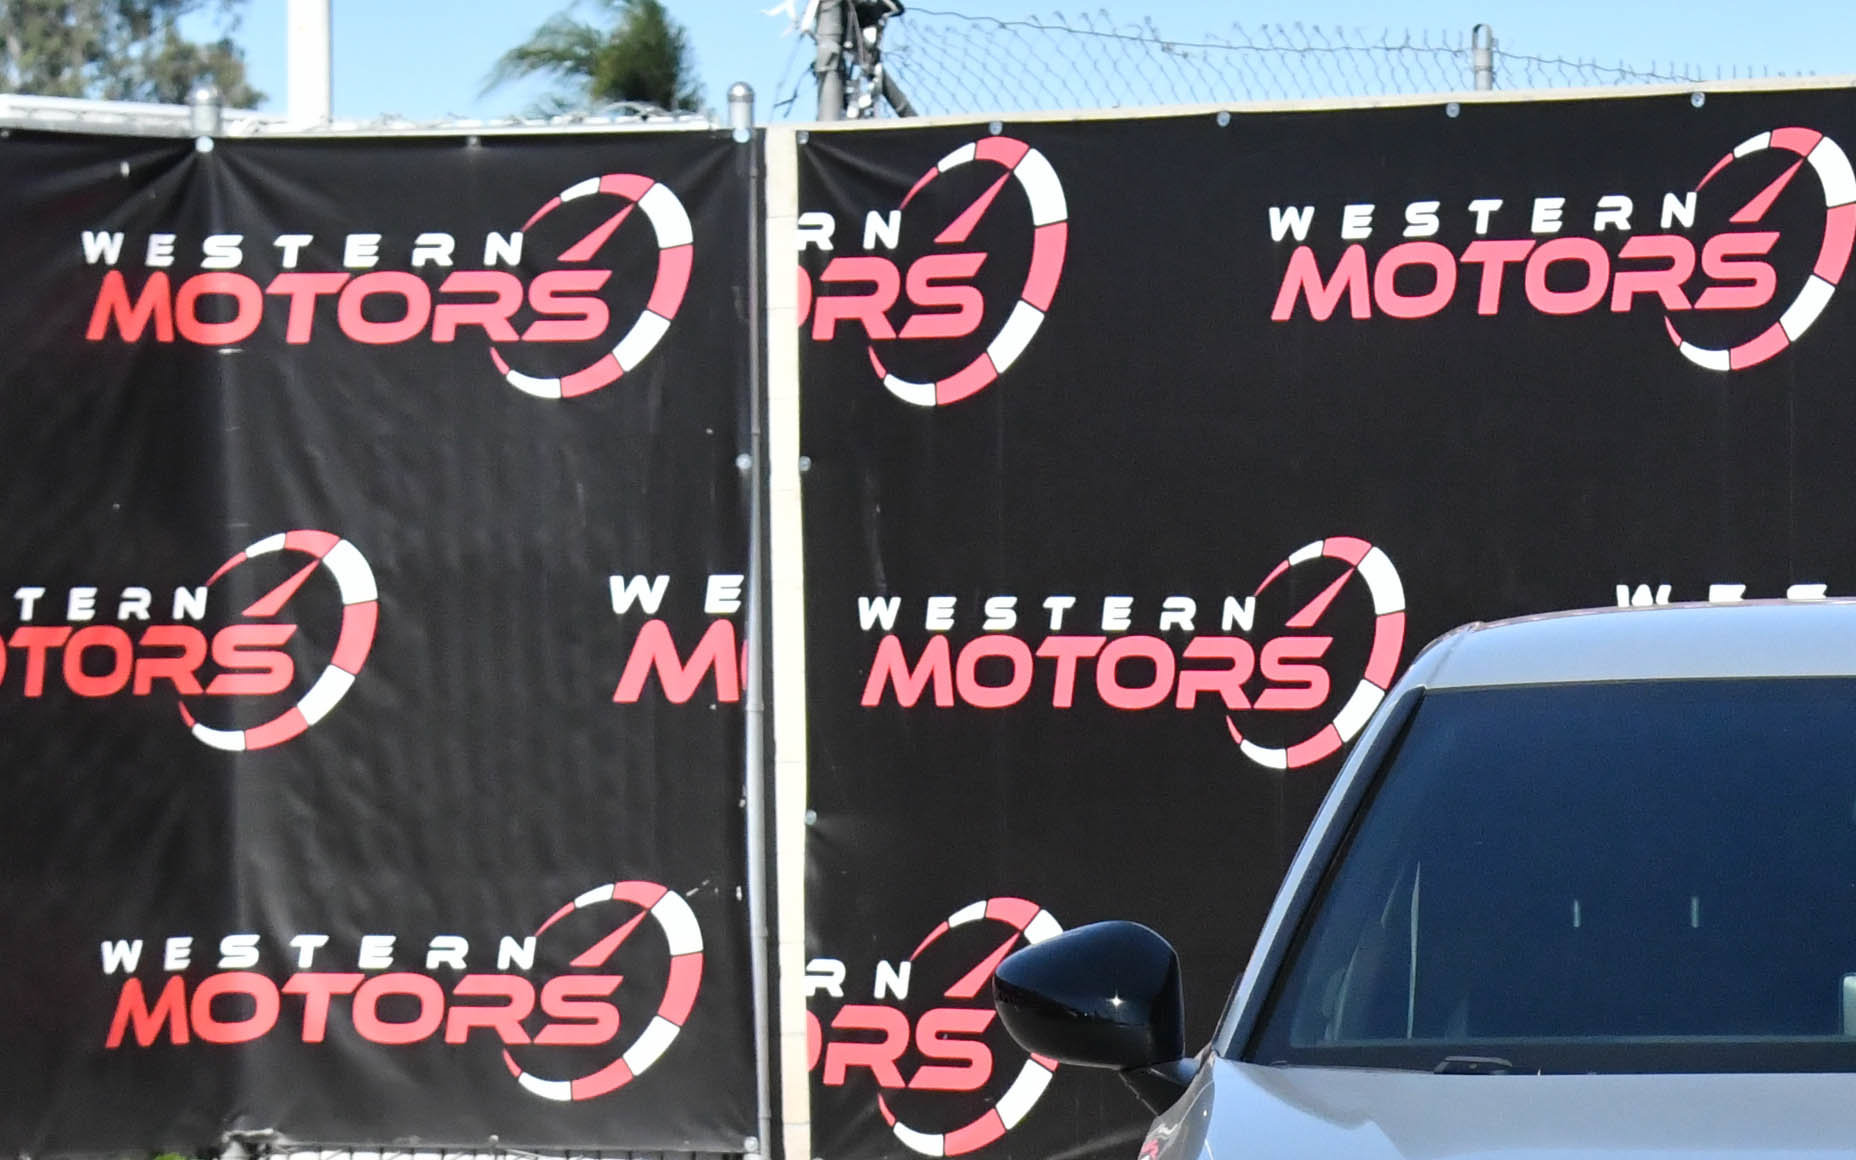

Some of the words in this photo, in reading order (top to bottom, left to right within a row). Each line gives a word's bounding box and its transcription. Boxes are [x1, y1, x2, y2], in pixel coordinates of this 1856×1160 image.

[82, 231, 523, 269] WESTERN
[1269, 192, 1697, 242] WESTERN
[86, 270, 612, 346] MOTORS
[1271, 232, 1780, 321] MOTORS
[858, 596, 1255, 631] WESTERN
[0, 624, 297, 697] TORS
[861, 634, 1333, 710] MOTORS
[102, 934, 536, 975] WESTERN
[106, 971, 623, 1048] MOTORS
